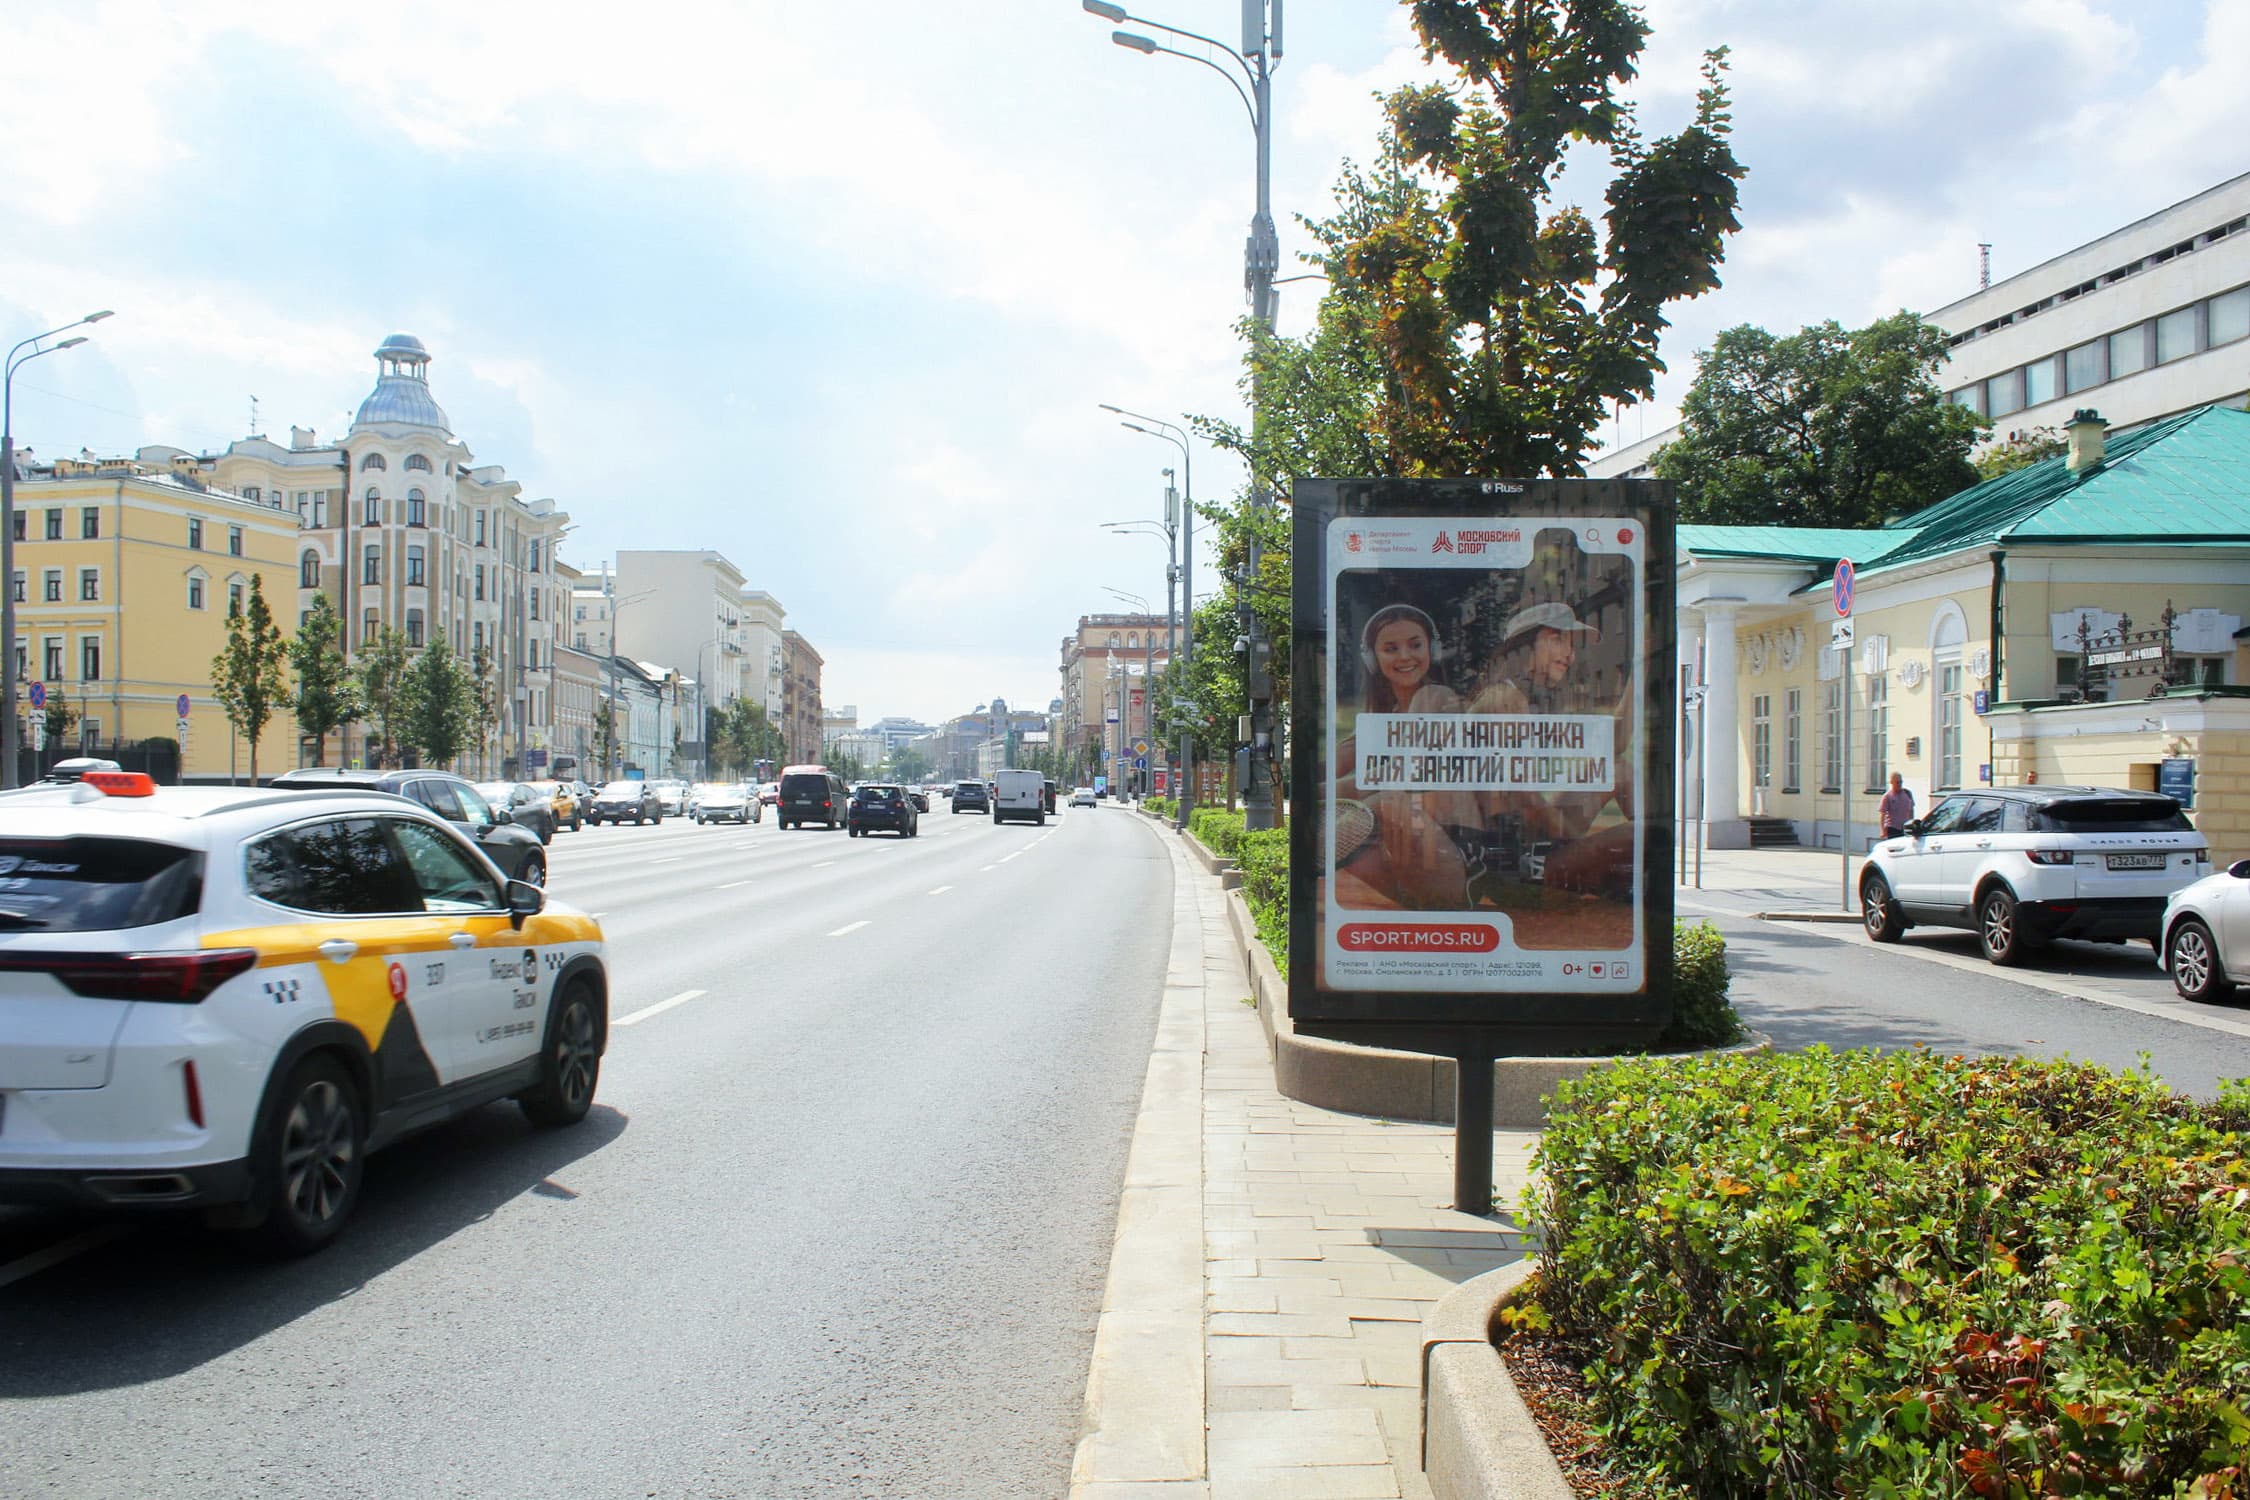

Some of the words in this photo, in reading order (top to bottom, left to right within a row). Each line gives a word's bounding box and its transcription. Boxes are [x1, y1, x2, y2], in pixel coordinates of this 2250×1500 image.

[1494, 483, 1524, 493] Russ
[1457, 528, 1521, 542] МОСКОВСКИЙ
[1457, 543, 1488, 554] СПОРТ
[1386, 717, 1456, 751] НАЙДИ
[1462, 721, 1585, 749] НАПАРНИКА
[1363, 755, 1405, 785] ДЛЯ
[1410, 752, 1504, 784] ЗАНЯТИЙ
[1510, 756, 1606, 784] СПОРТОМ
[1350, 931, 1485, 945] SPORT.MOS.RU
[1563, 963, 1583, 975] 0+
